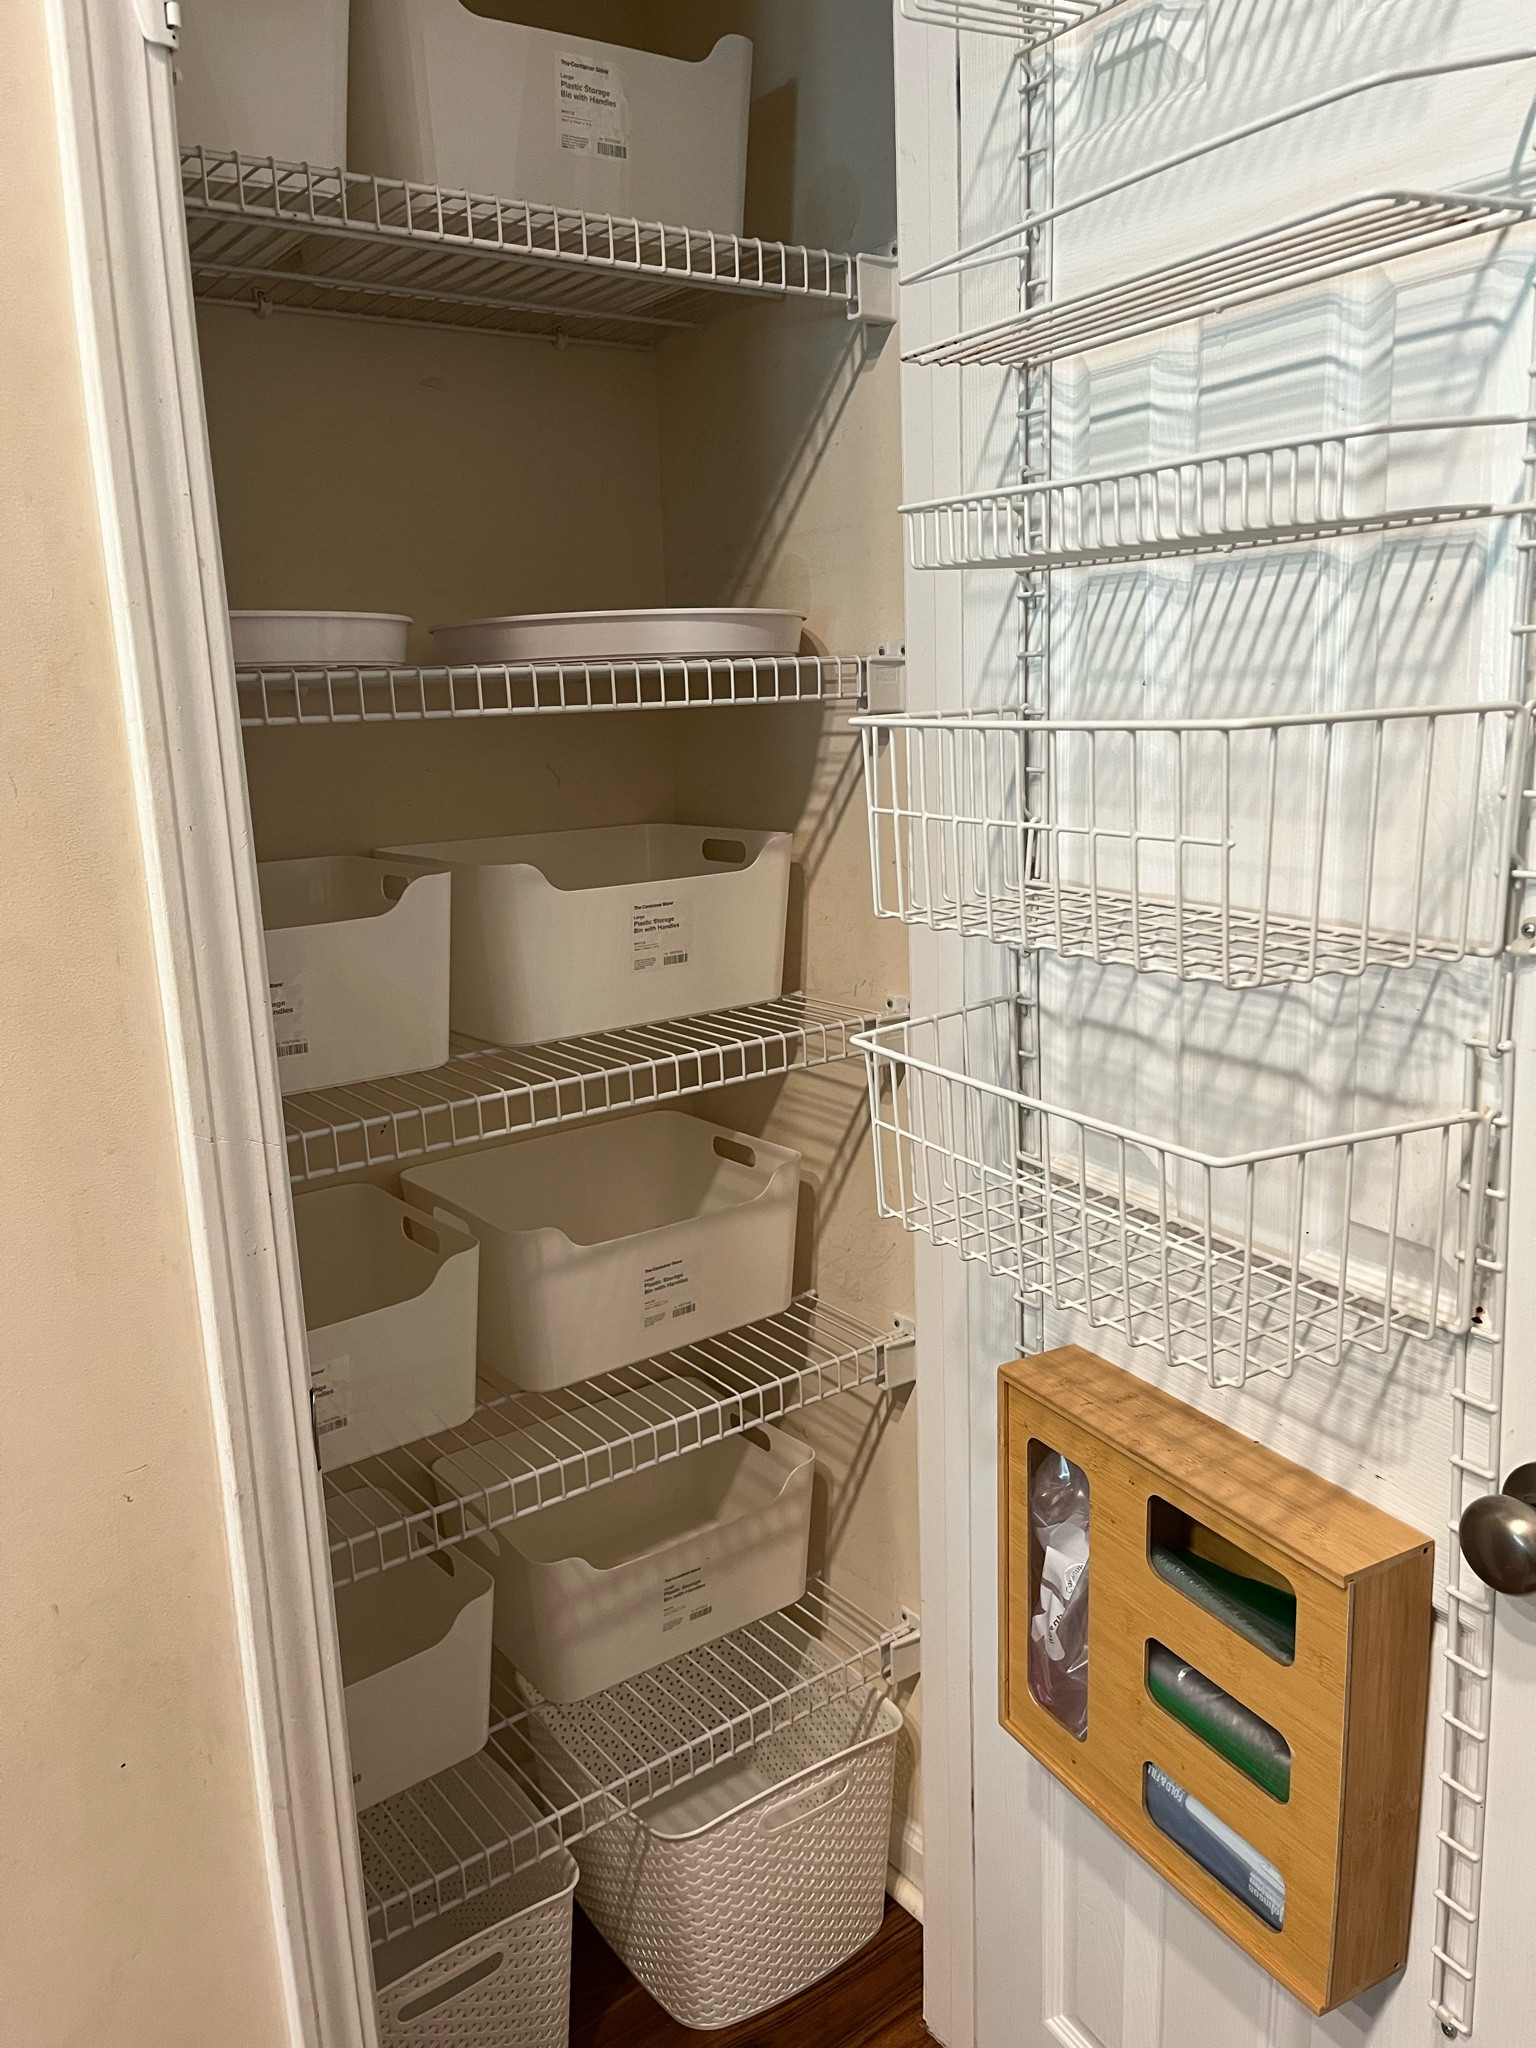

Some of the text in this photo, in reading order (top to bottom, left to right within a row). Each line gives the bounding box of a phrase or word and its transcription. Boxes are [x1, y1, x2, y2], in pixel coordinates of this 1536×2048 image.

[560, 81, 611, 98] Plastic Storage
[560, 90, 617, 108] Bin with Handles
[1147, 1763, 1184, 1802] FOLD & FILL
